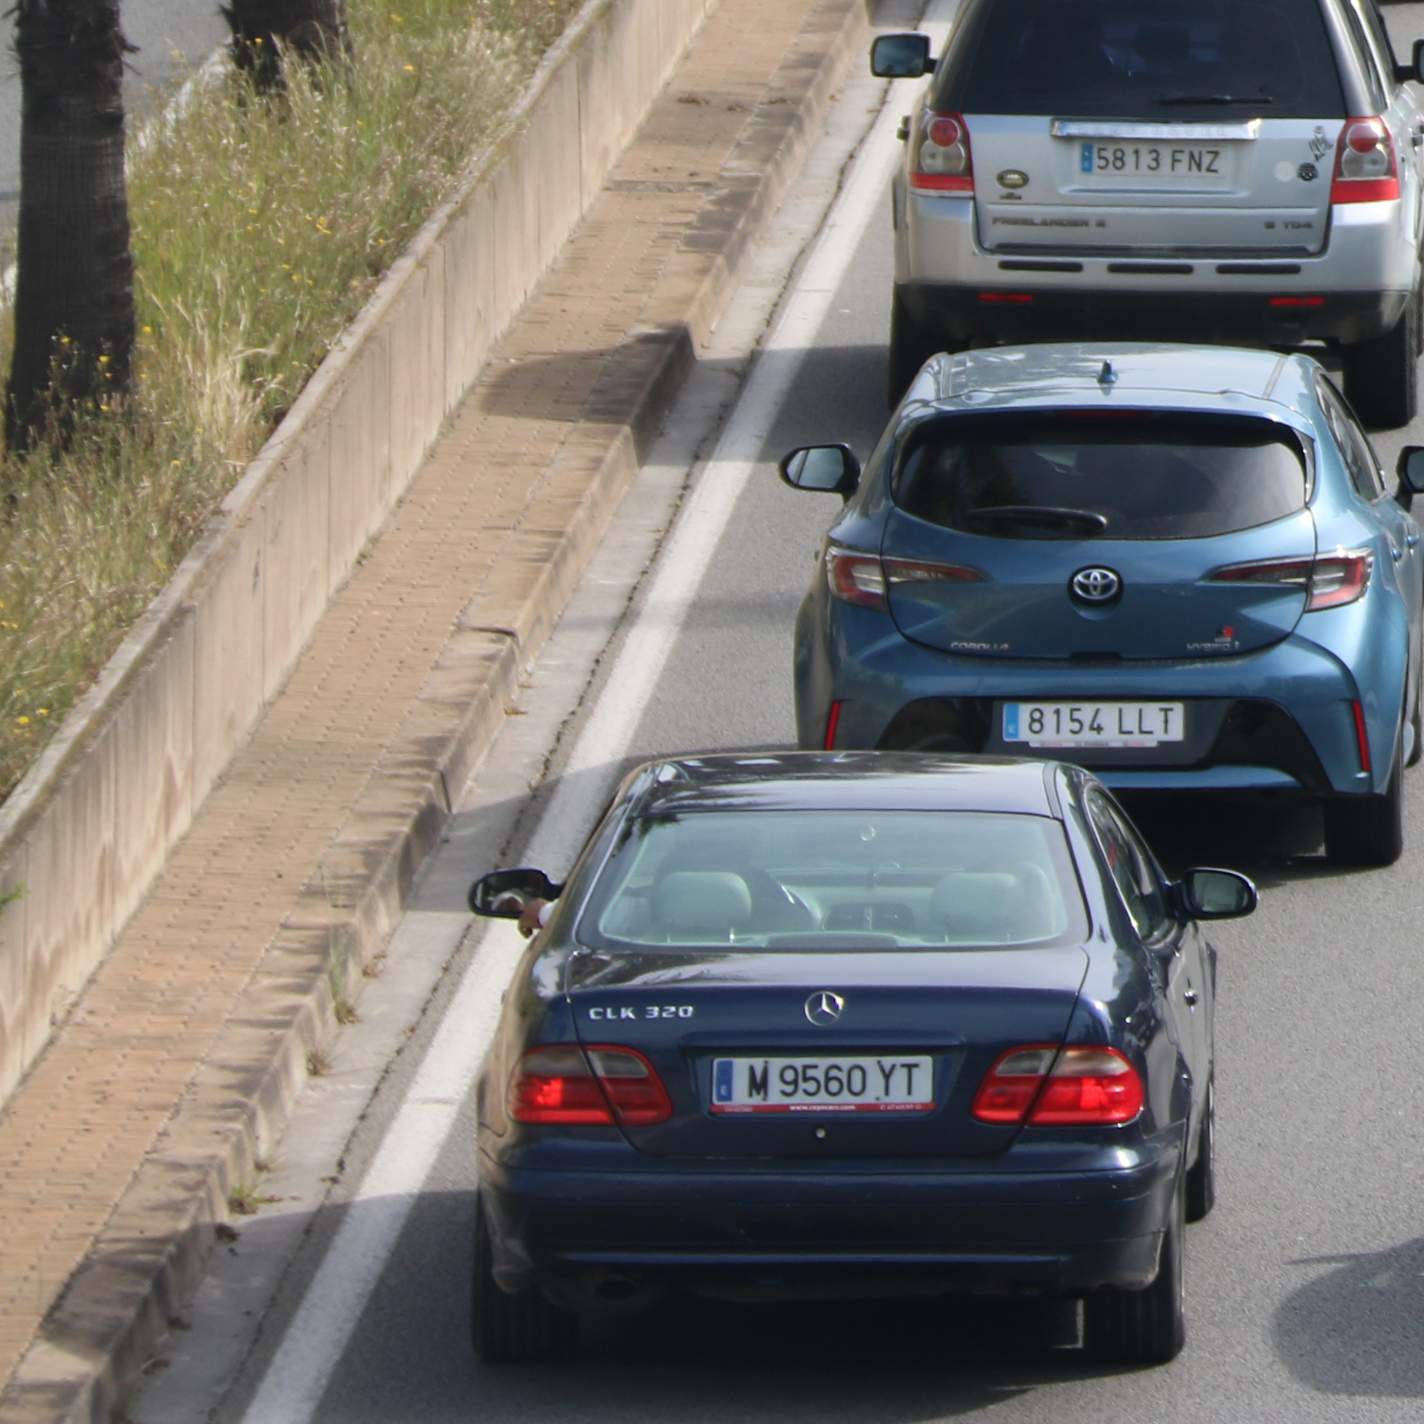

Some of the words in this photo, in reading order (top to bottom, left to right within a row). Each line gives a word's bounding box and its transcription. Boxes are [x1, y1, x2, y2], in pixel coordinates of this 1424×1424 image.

[1096, 147, 1161, 171] 5813
[1170, 149, 1221, 173] FNZ
[1027, 707, 1104, 735] 8154
[1117, 707, 1175, 735] LLT
[588, 1007, 637, 1020] CLK
[644, 1005, 696, 1019] 320
[747, 1060, 770, 1100] M
[778, 1063, 868, 1097] 9560
[875, 1060, 921, 1097] YT
